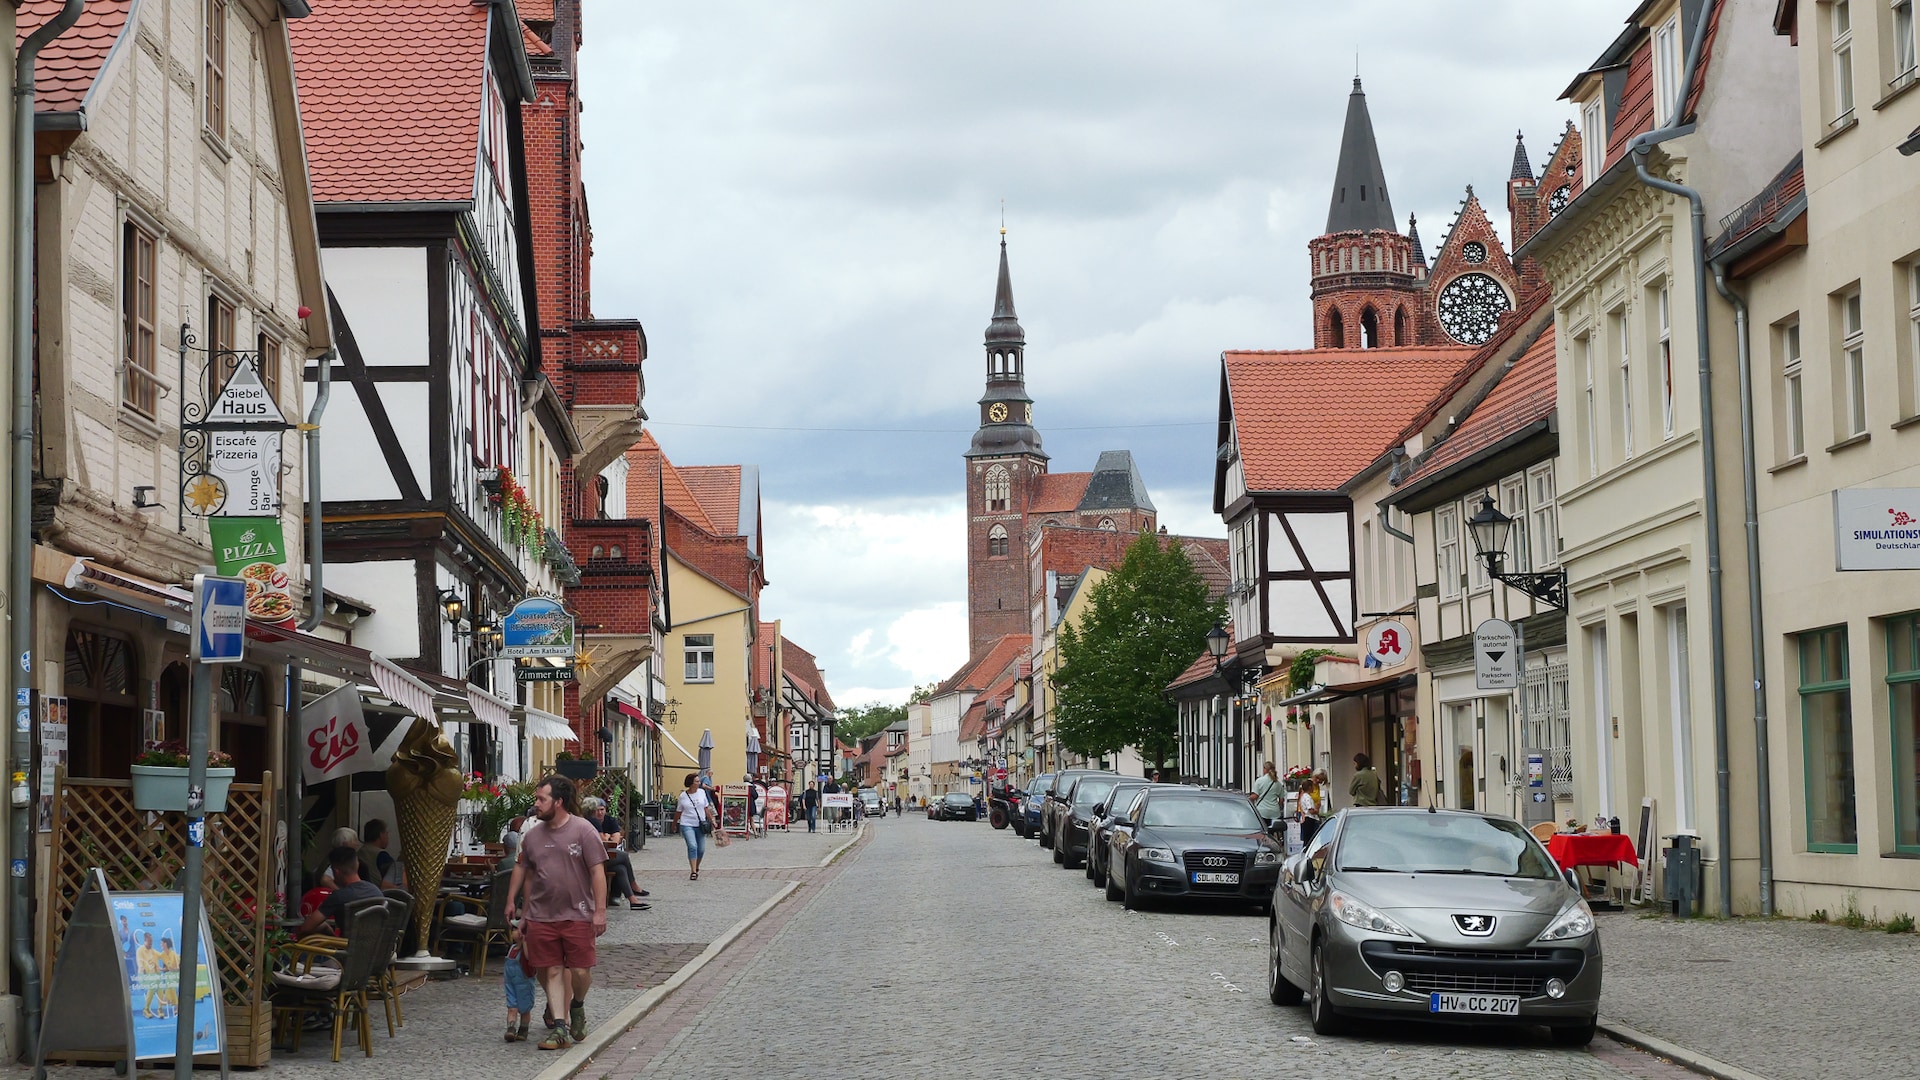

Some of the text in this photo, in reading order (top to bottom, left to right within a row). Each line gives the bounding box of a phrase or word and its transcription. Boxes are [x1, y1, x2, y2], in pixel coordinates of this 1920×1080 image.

[225, 388, 264, 399] Giebel
[222, 400, 267, 415] Haus
[215, 435, 257, 447] Eiscafé
[215, 449, 258, 460] Pizzeria
[248, 469, 261, 511] Lounge
[261, 491, 271, 511] Bar
[1853, 529, 1920, 540] SIMULATIONS
[222, 541, 278, 562] PIZZA
[518, 669, 572, 680] Zimmer frei
[307, 716, 359, 769] Eis
[1440, 996, 1459, 1010] HV
[1468, 997, 1488, 1011] CC
[1490, 998, 1518, 1013] 207
